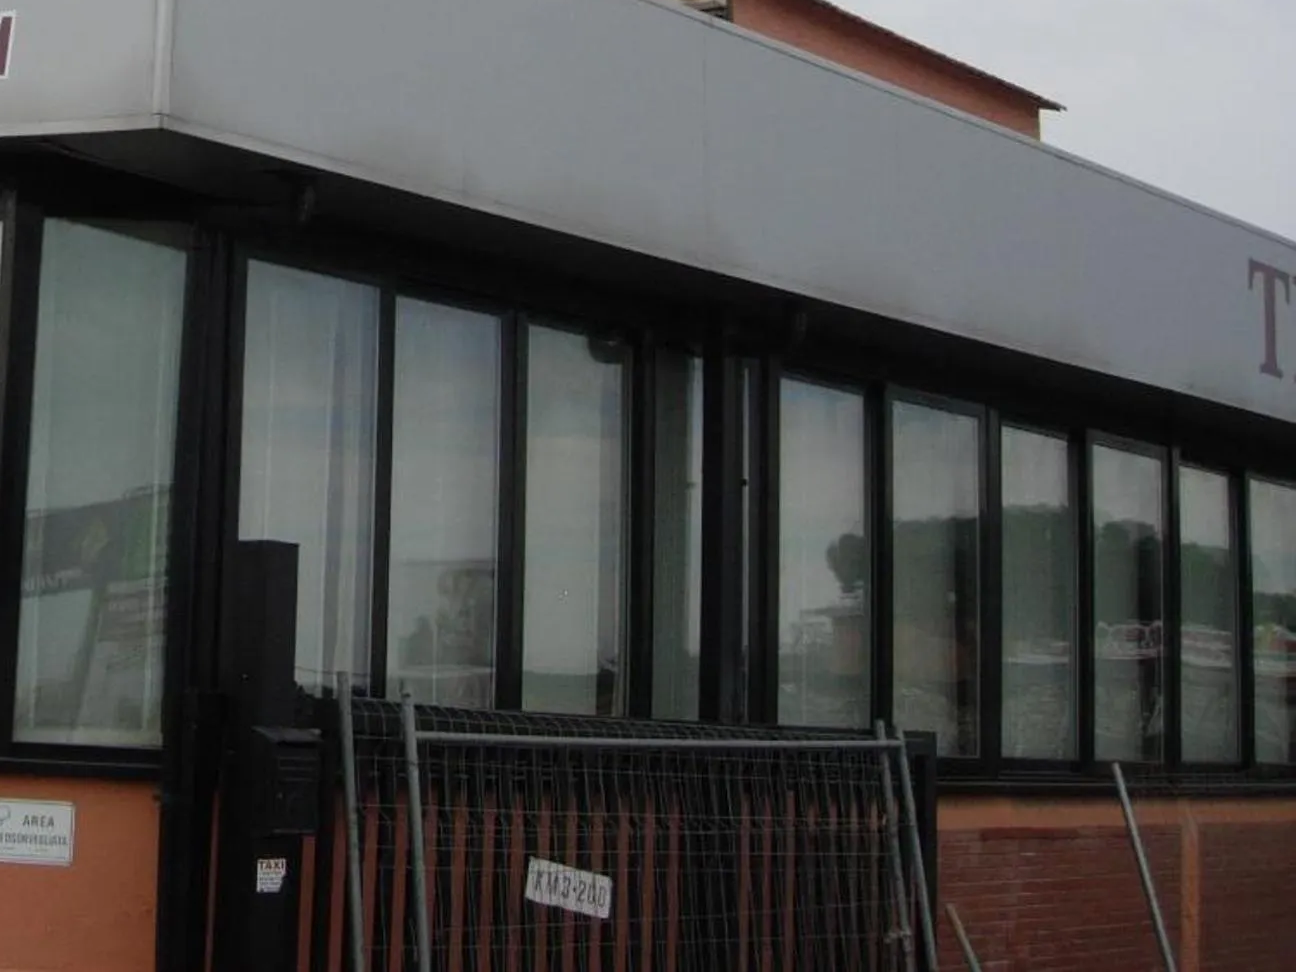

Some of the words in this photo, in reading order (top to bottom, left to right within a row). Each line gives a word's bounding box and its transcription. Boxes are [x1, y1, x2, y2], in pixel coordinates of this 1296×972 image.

[1247, 257, 1296, 383] T
[22, 814, 55, 828] AREA
[258, 859, 284, 871] TAXI
